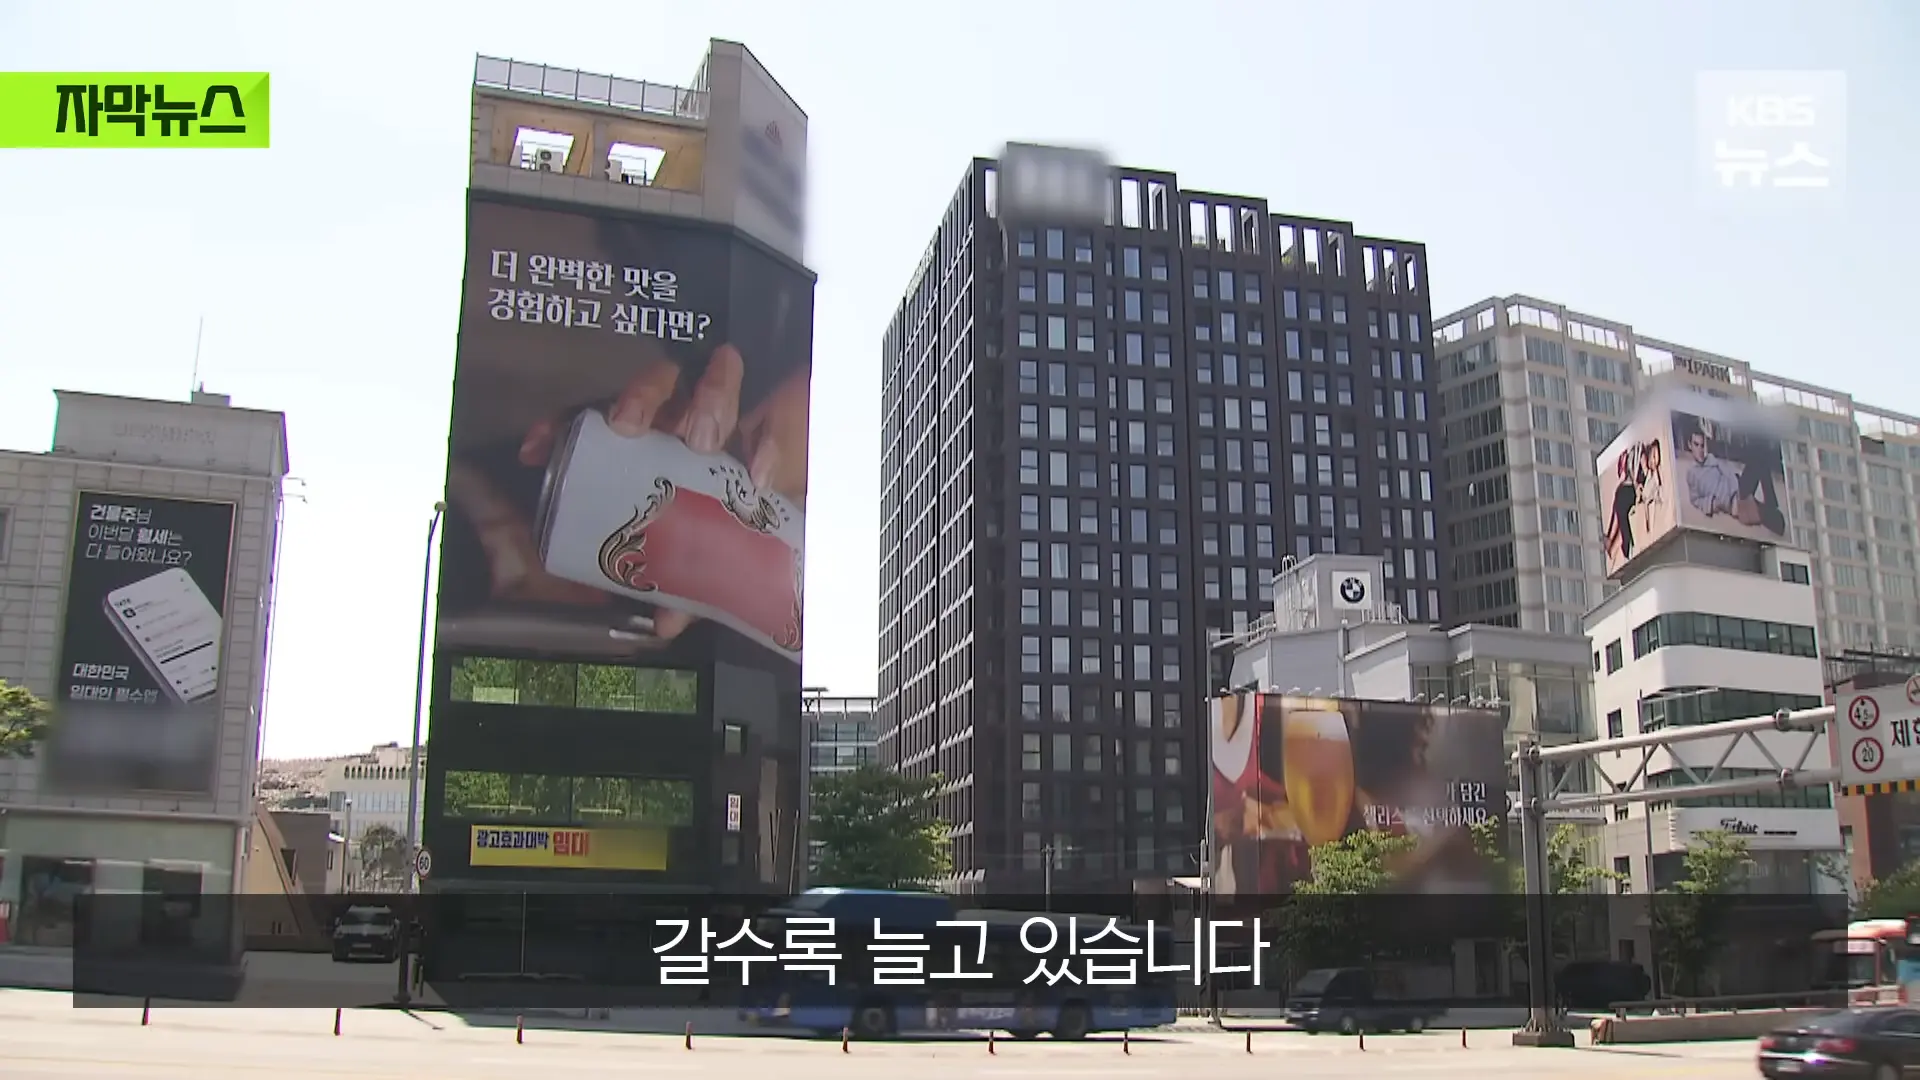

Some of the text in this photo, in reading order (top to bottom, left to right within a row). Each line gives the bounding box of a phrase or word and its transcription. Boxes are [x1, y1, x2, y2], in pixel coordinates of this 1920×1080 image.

[491, 249, 678, 303] 더 완벽한 맛을
[488, 287, 711, 342] 경험하고 싶다면?
[88, 524, 184, 547] 이번달 월세는
[86, 543, 192, 566] 다 들어왔나요?
[72, 662, 130, 681] 대한민국
[1862, 746, 1874, 763] 20
[1460, 782, 1486, 802] 담긴
[1422, 805, 1488, 828] 선택하세요
[553, 831, 590, 857] 임대
[419, 856, 429, 871] 60
